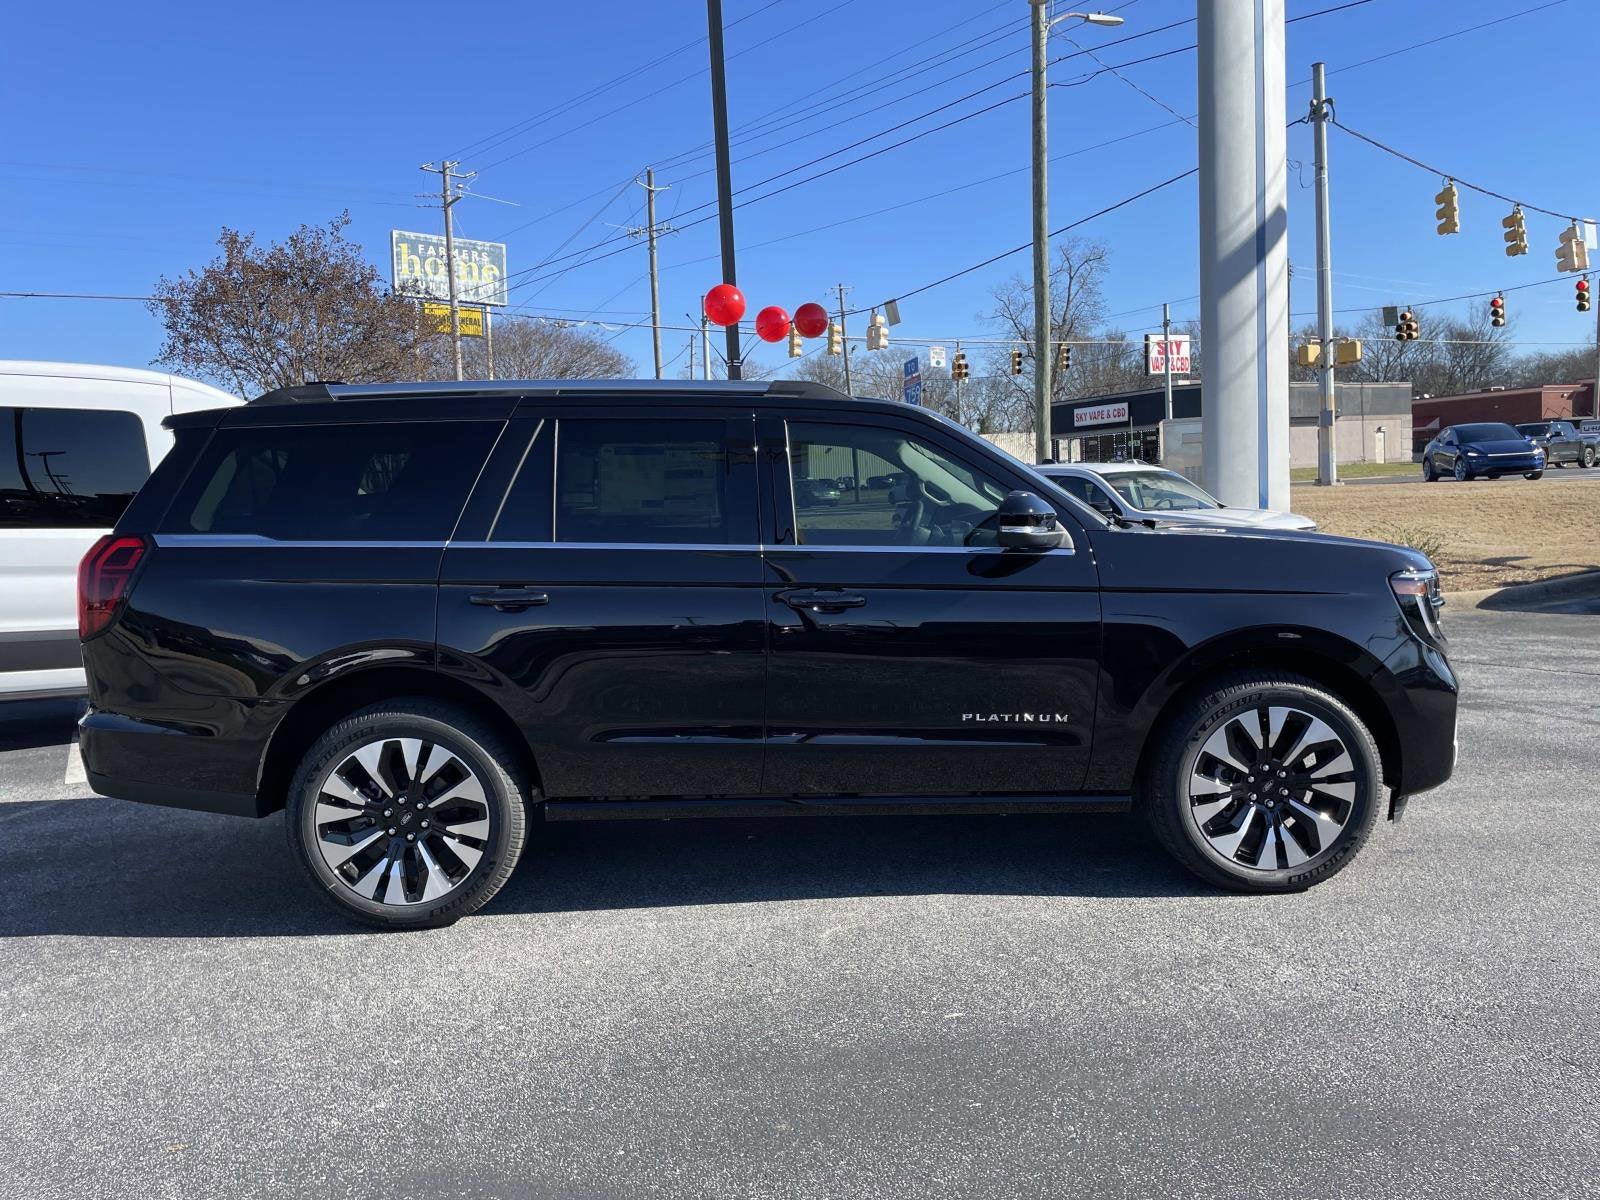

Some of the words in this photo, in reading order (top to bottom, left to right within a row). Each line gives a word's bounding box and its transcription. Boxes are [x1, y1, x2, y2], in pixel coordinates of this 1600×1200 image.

[398, 242, 500, 283] home
[1170, 356, 1175, 371] &
[1176, 356, 1189, 371] CBD
[1075, 412, 1089, 423] SKY
[1089, 410, 1105, 421] VAPE
[1106, 409, 1111, 419] &
[1112, 407, 1126, 418] CBD
[962, 713, 1068, 722] PLATINUM
